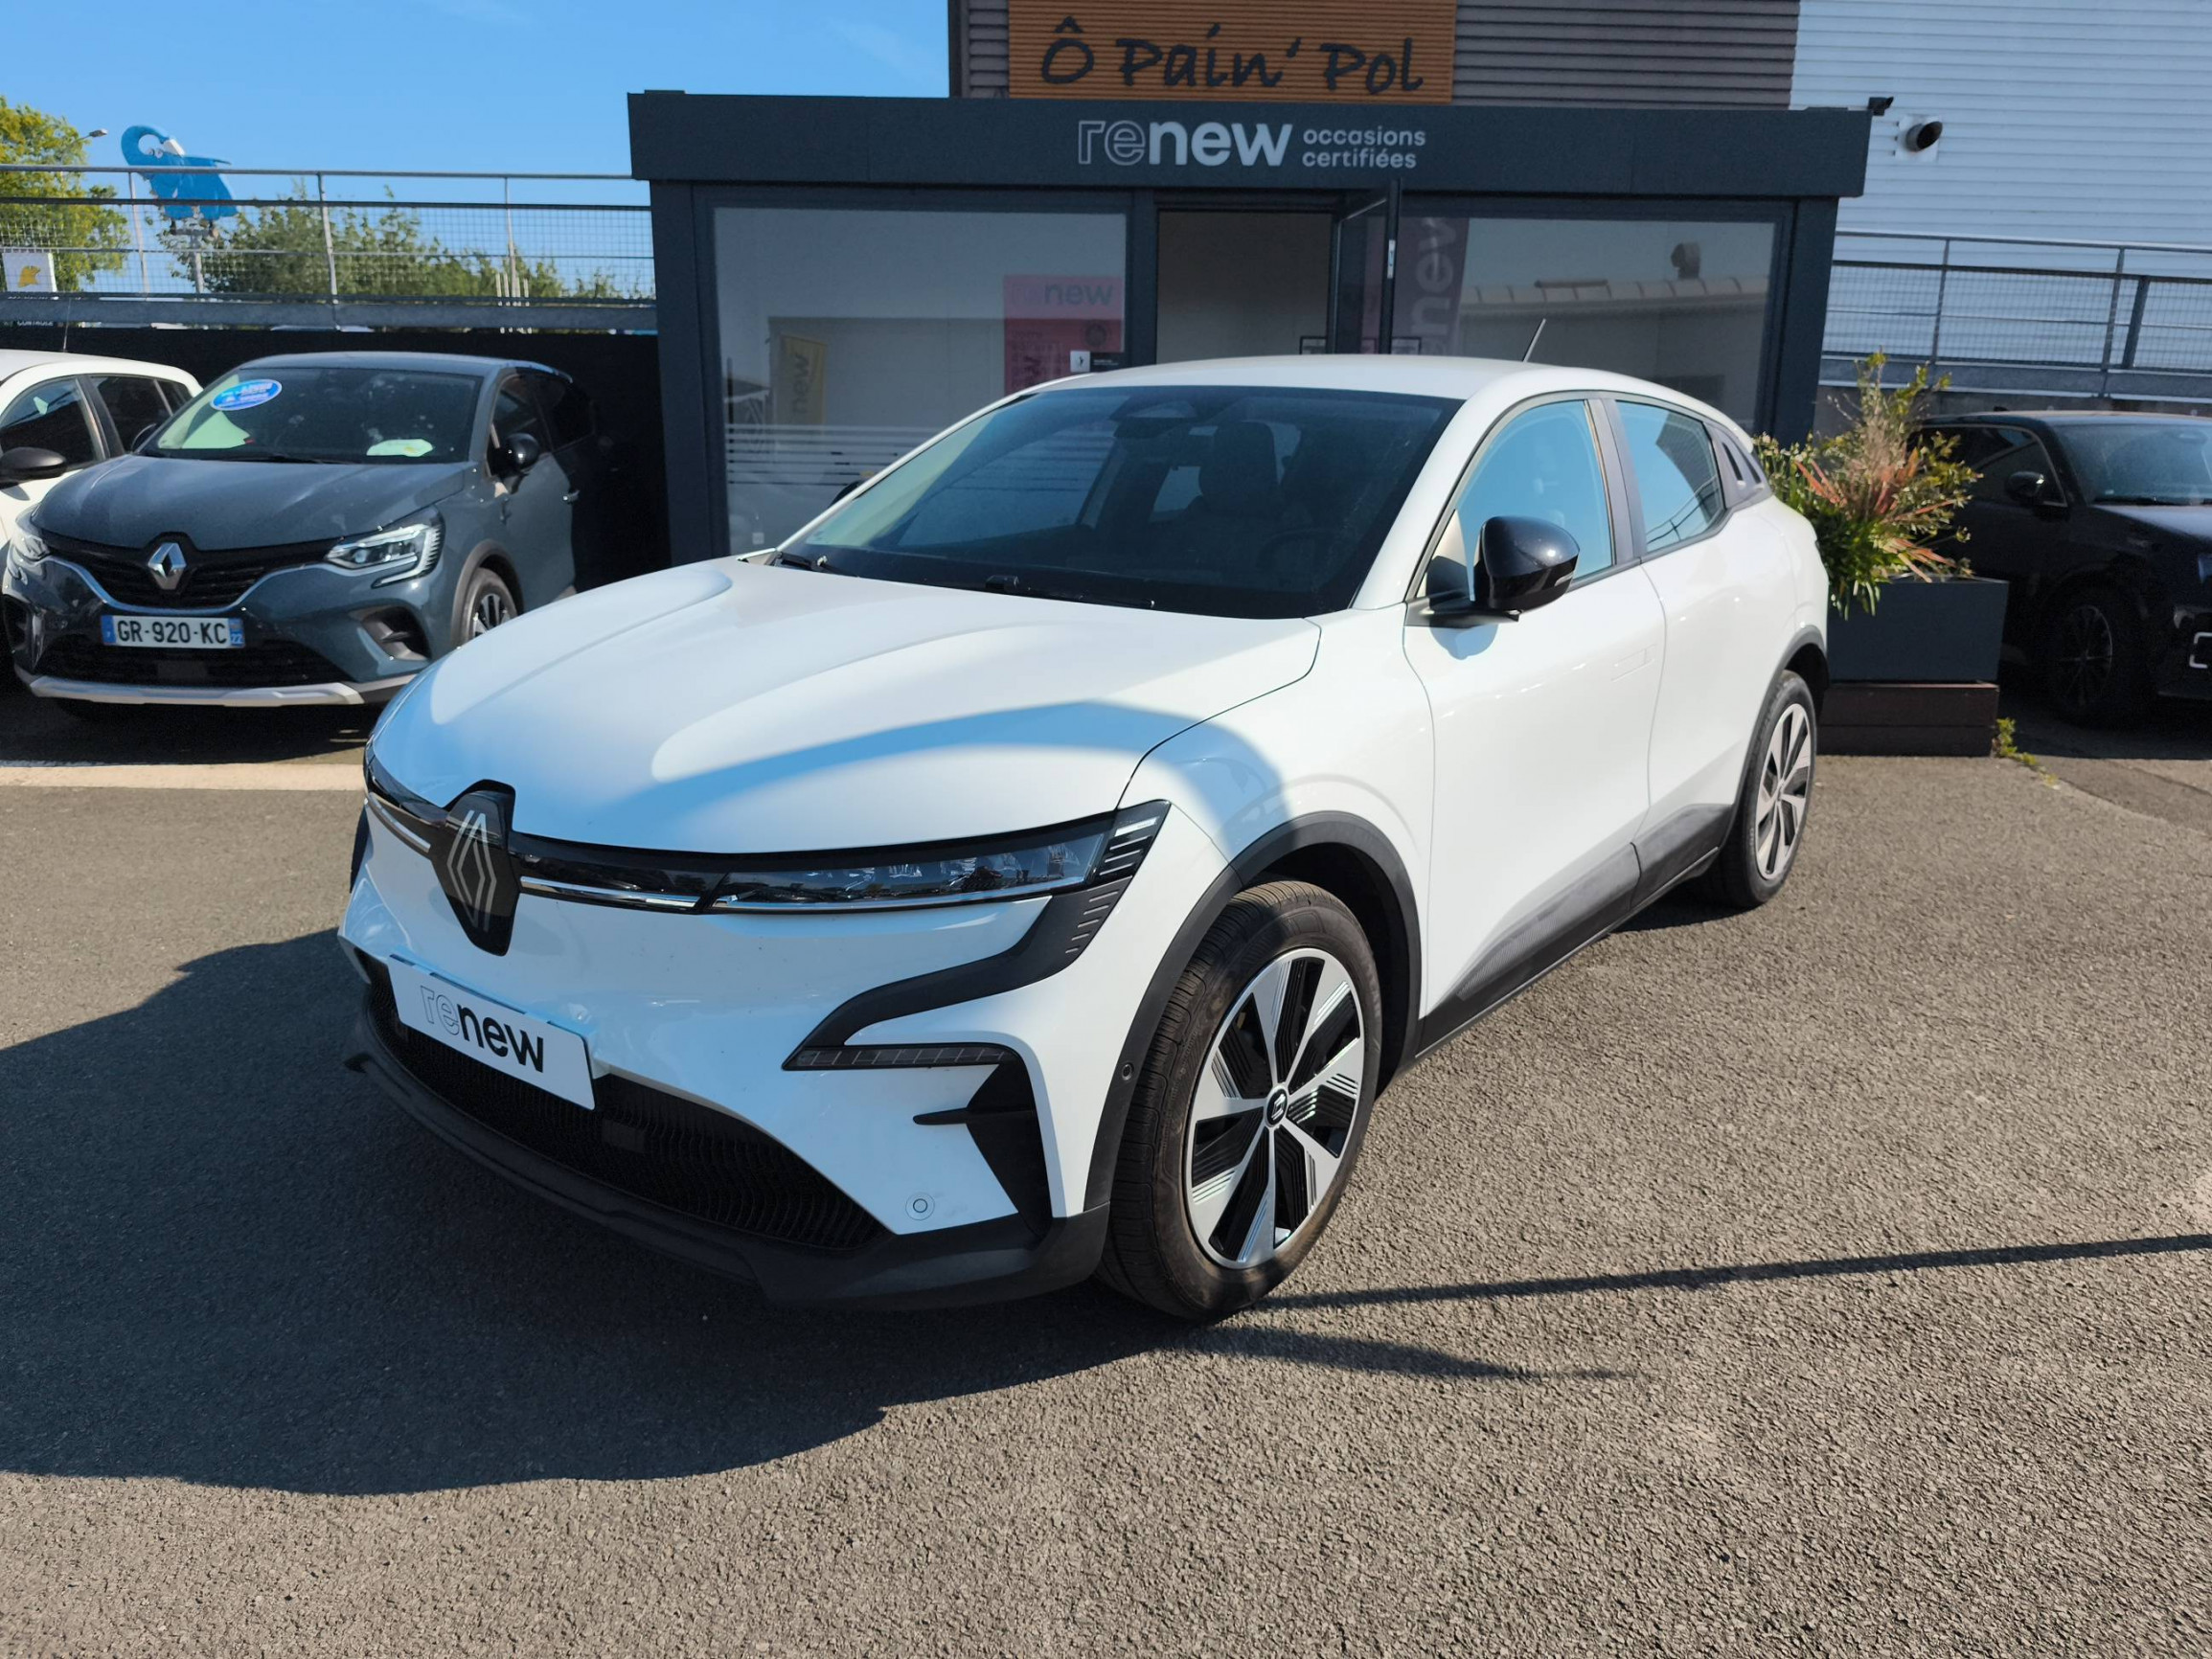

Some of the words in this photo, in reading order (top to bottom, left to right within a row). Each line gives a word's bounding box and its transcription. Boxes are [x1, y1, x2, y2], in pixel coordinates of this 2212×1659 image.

[1041, 16, 1094, 84] Ô
[1319, 36, 1425, 95] Pol
[1078, 120, 1293, 167] renew
[1302, 125, 1426, 147] occasions
[1302, 148, 1417, 169] certifiées
[117, 620, 228, 645] GR-920-KC
[420, 985, 544, 1074] renew
